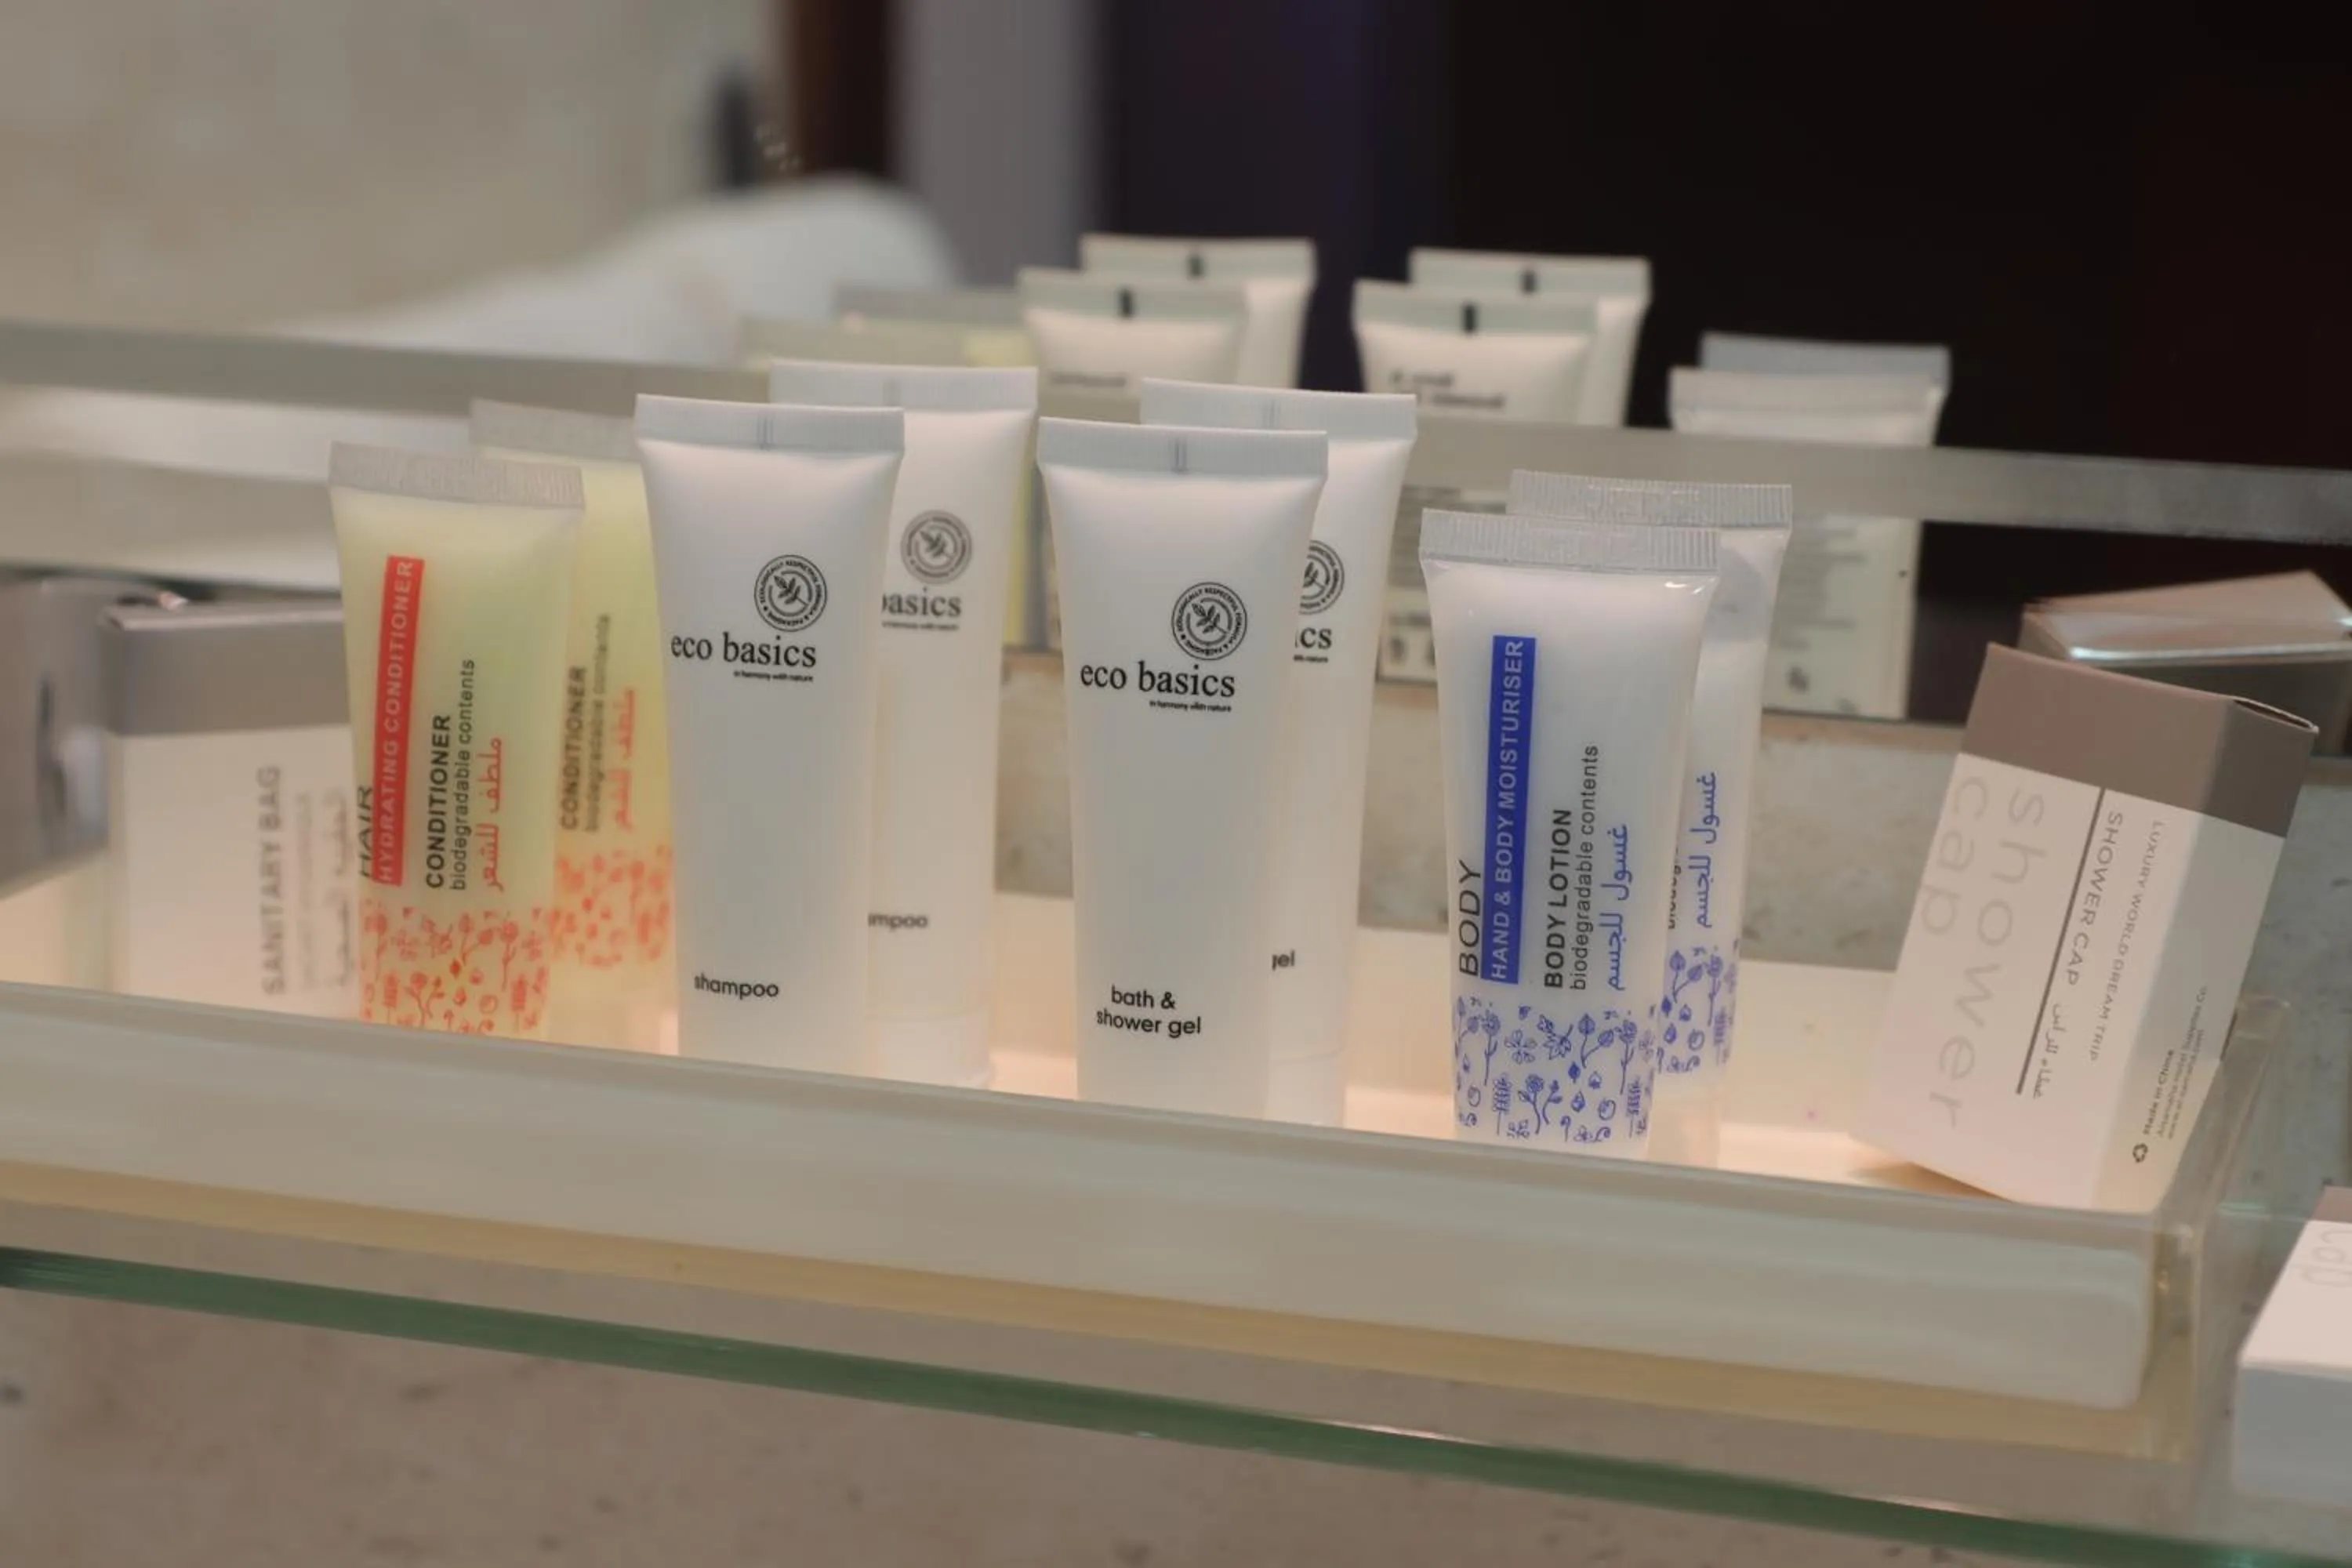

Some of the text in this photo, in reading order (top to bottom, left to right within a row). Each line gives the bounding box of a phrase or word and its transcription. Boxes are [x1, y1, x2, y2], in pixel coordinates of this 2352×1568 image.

[379, 561, 413, 883] HYDRATING CONDITIONER
[671, 632, 816, 667] eco basics
[1080, 661, 1236, 697] eco basics
[256, 766, 282, 831] BAG
[426, 714, 452, 888] CONDITIONER
[449, 659, 475, 891] biodegradable contents
[560, 666, 587, 831] CONDITIONER
[1491, 640, 1524, 980] HAND & BODY MOISTURISER
[358, 785, 373, 879] HAIR
[1544, 808, 1572, 989] BODY LOTION
[1570, 745, 1599, 991] biodegradable contents
[1921, 776, 1988, 938] cap
[2067, 812, 2123, 987] SHOWER CAP
[694, 972, 779, 1000] shampoo
[868, 913, 928, 931] mpoo
[1111, 984, 1176, 1009] bath &
[1272, 949, 1295, 971] el
[1457, 859, 1482, 976] BODY
[1929, 786, 2048, 1129] shower
[2089, 819, 2169, 1062] LUXURY WORLD DREAM TRIP
[1097, 1007, 1201, 1039] shower gel
